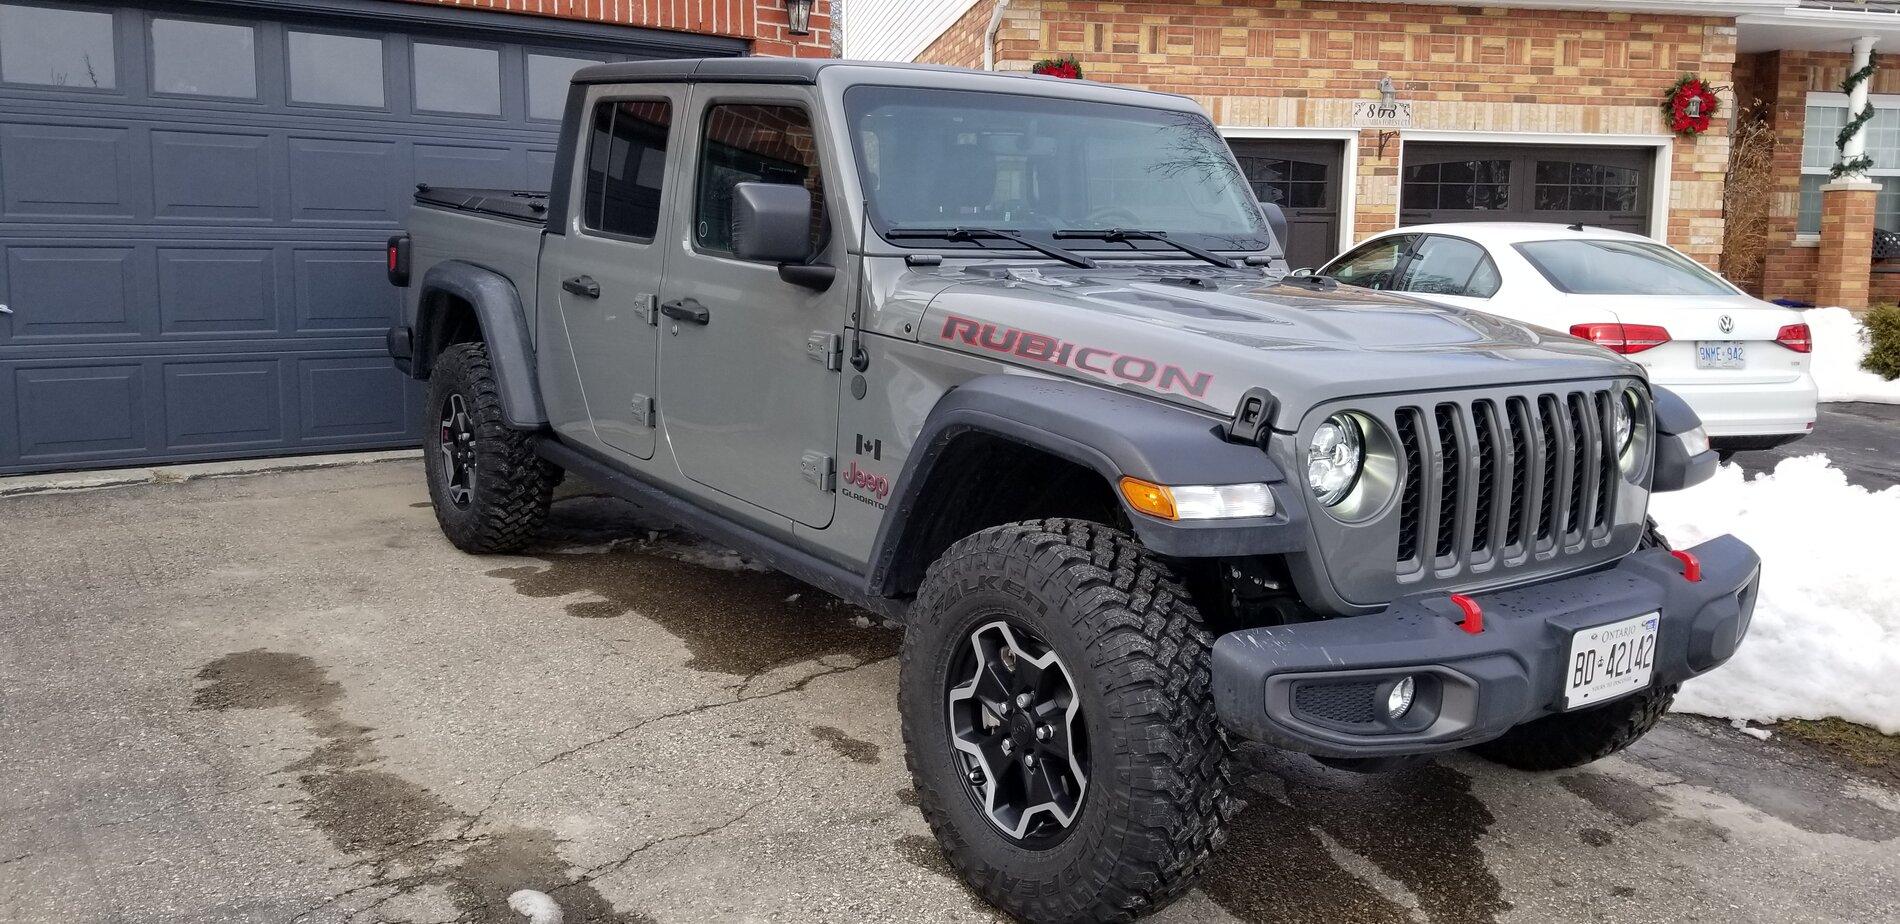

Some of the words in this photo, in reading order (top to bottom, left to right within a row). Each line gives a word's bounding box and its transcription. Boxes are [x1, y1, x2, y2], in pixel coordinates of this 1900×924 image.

[941, 315, 1214, 399] RUBICON
[1727, 347, 1744, 361] 942
[843, 461, 889, 500] Jeep
[1601, 625, 1636, 643] ONTARIO
[1573, 649, 1597, 688] BD
[1606, 634, 1654, 679] 42142
